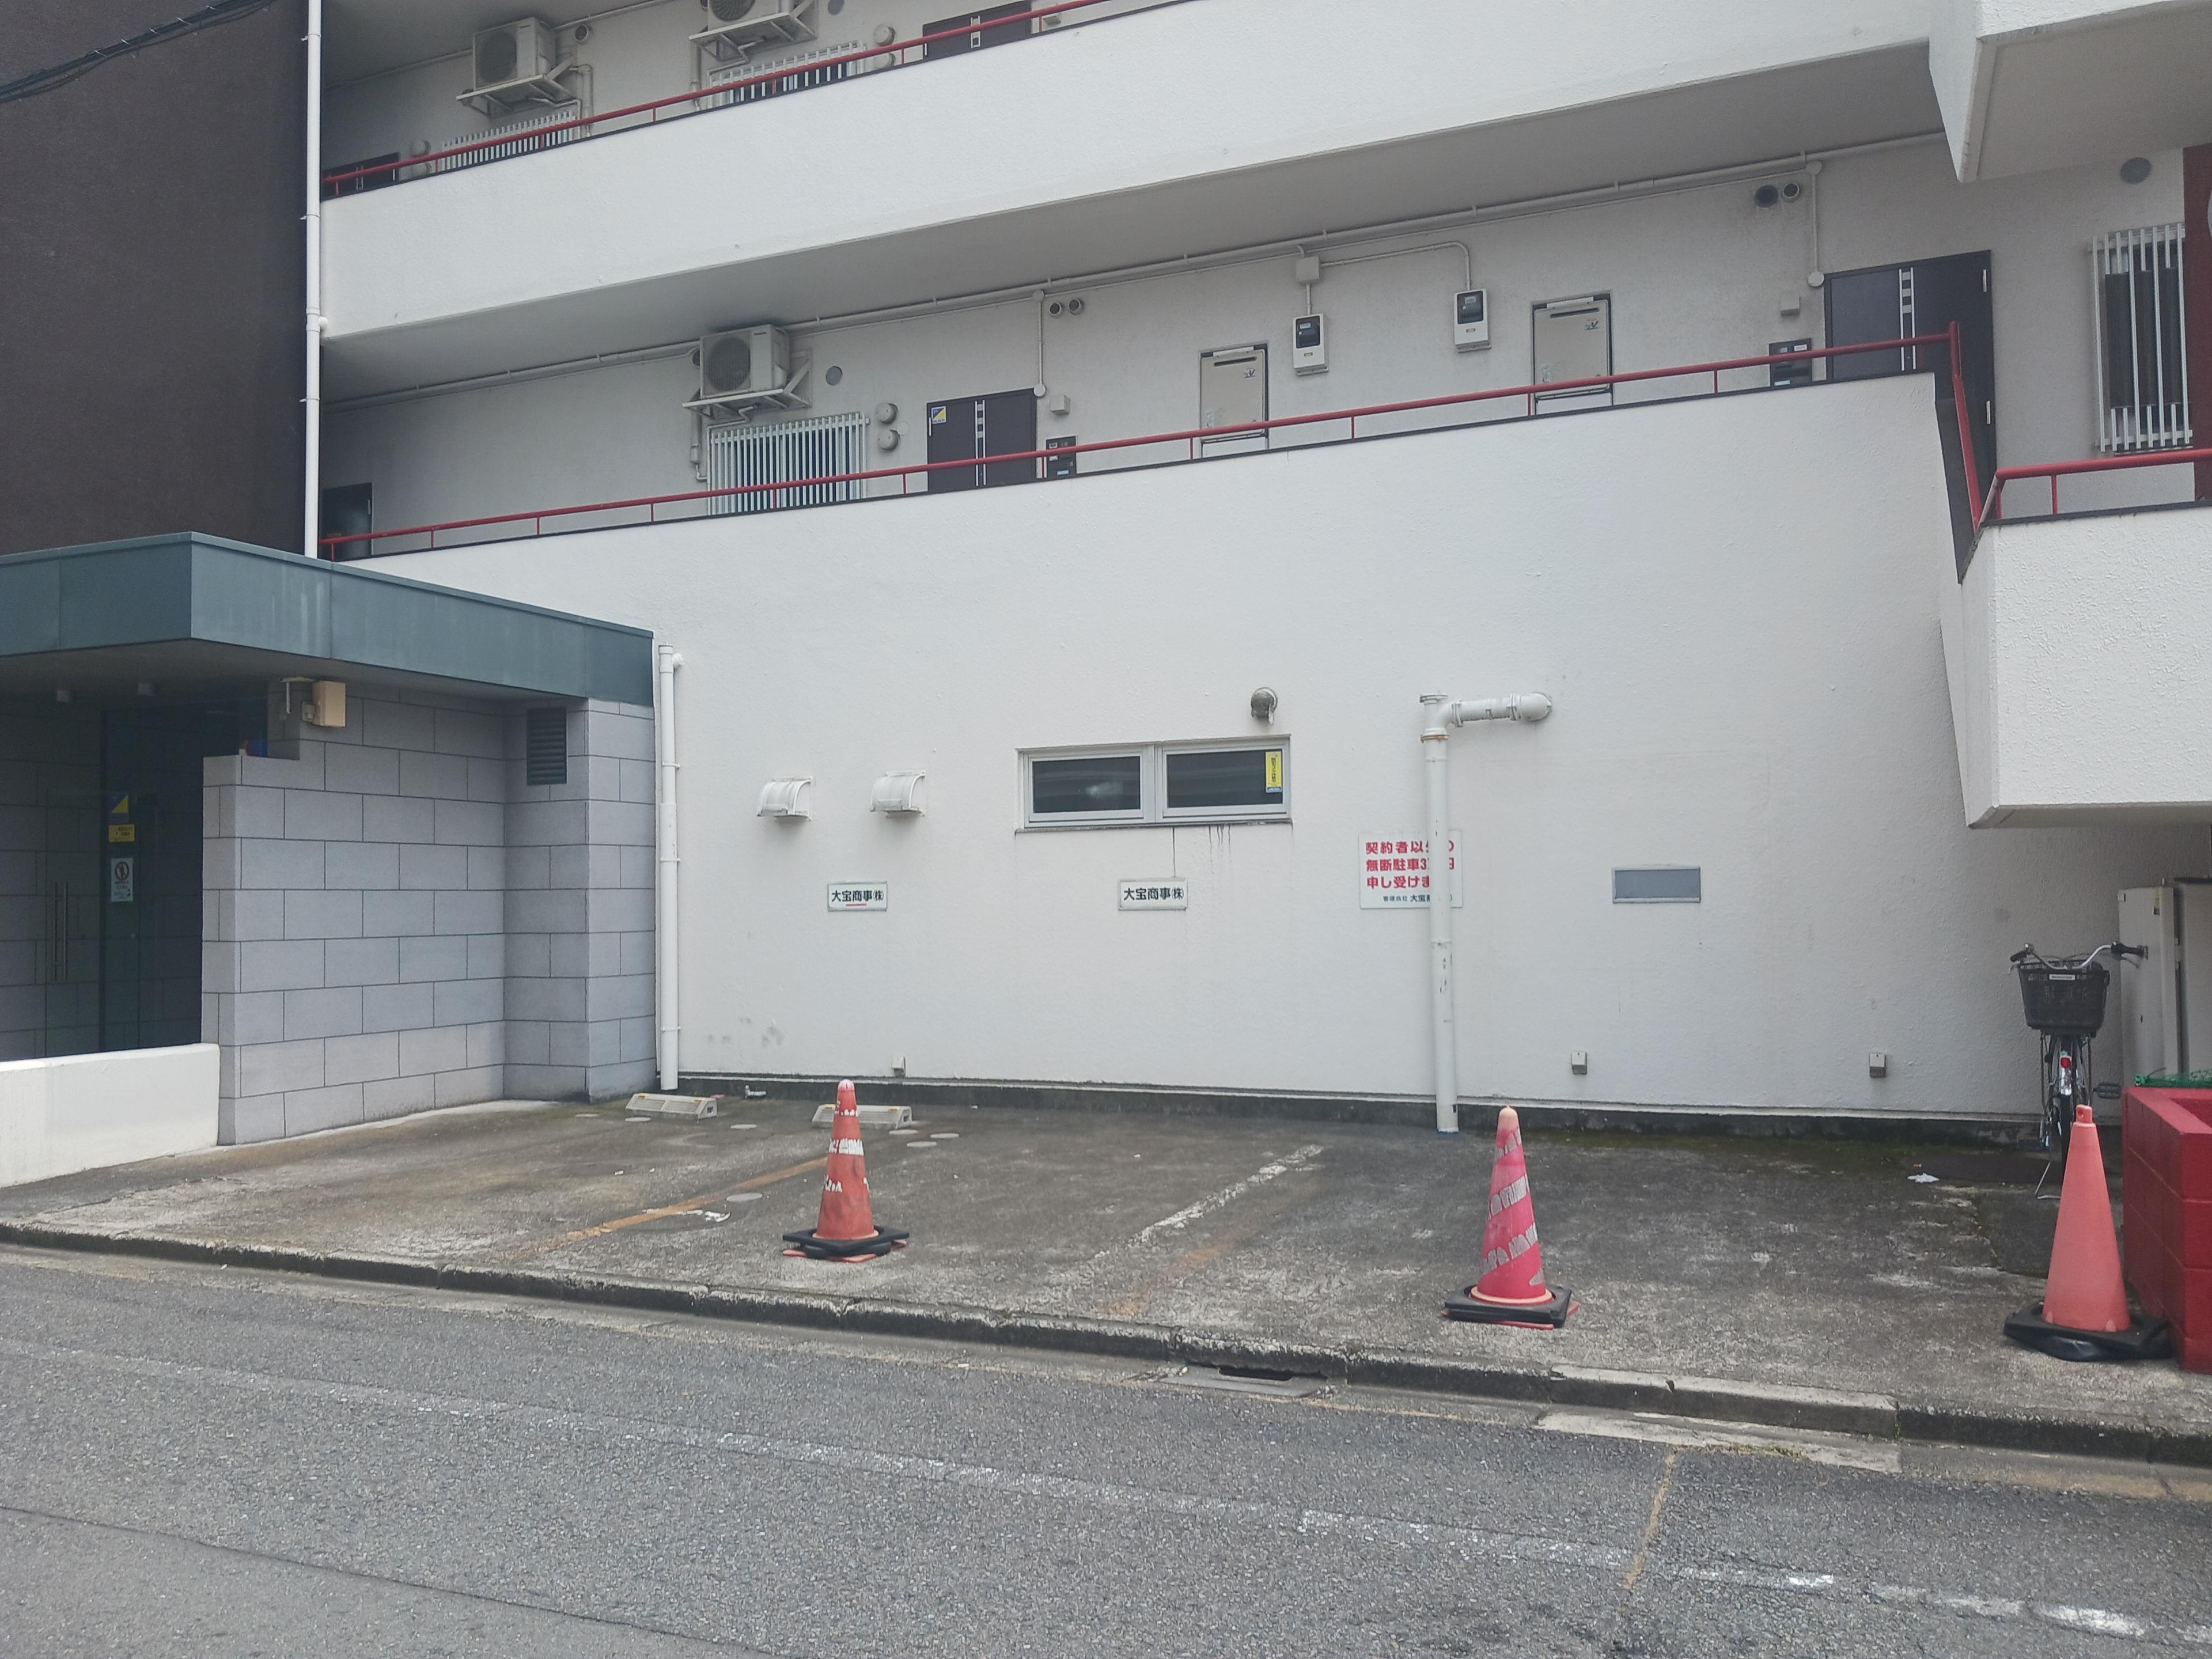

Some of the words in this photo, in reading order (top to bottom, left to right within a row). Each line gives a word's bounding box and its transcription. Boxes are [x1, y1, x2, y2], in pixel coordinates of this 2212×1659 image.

[1365, 840, 1455, 854] 契約者以
[1366, 857, 1455, 872] 無断駐車3
[1367, 875, 1430, 889] 申し受けま
